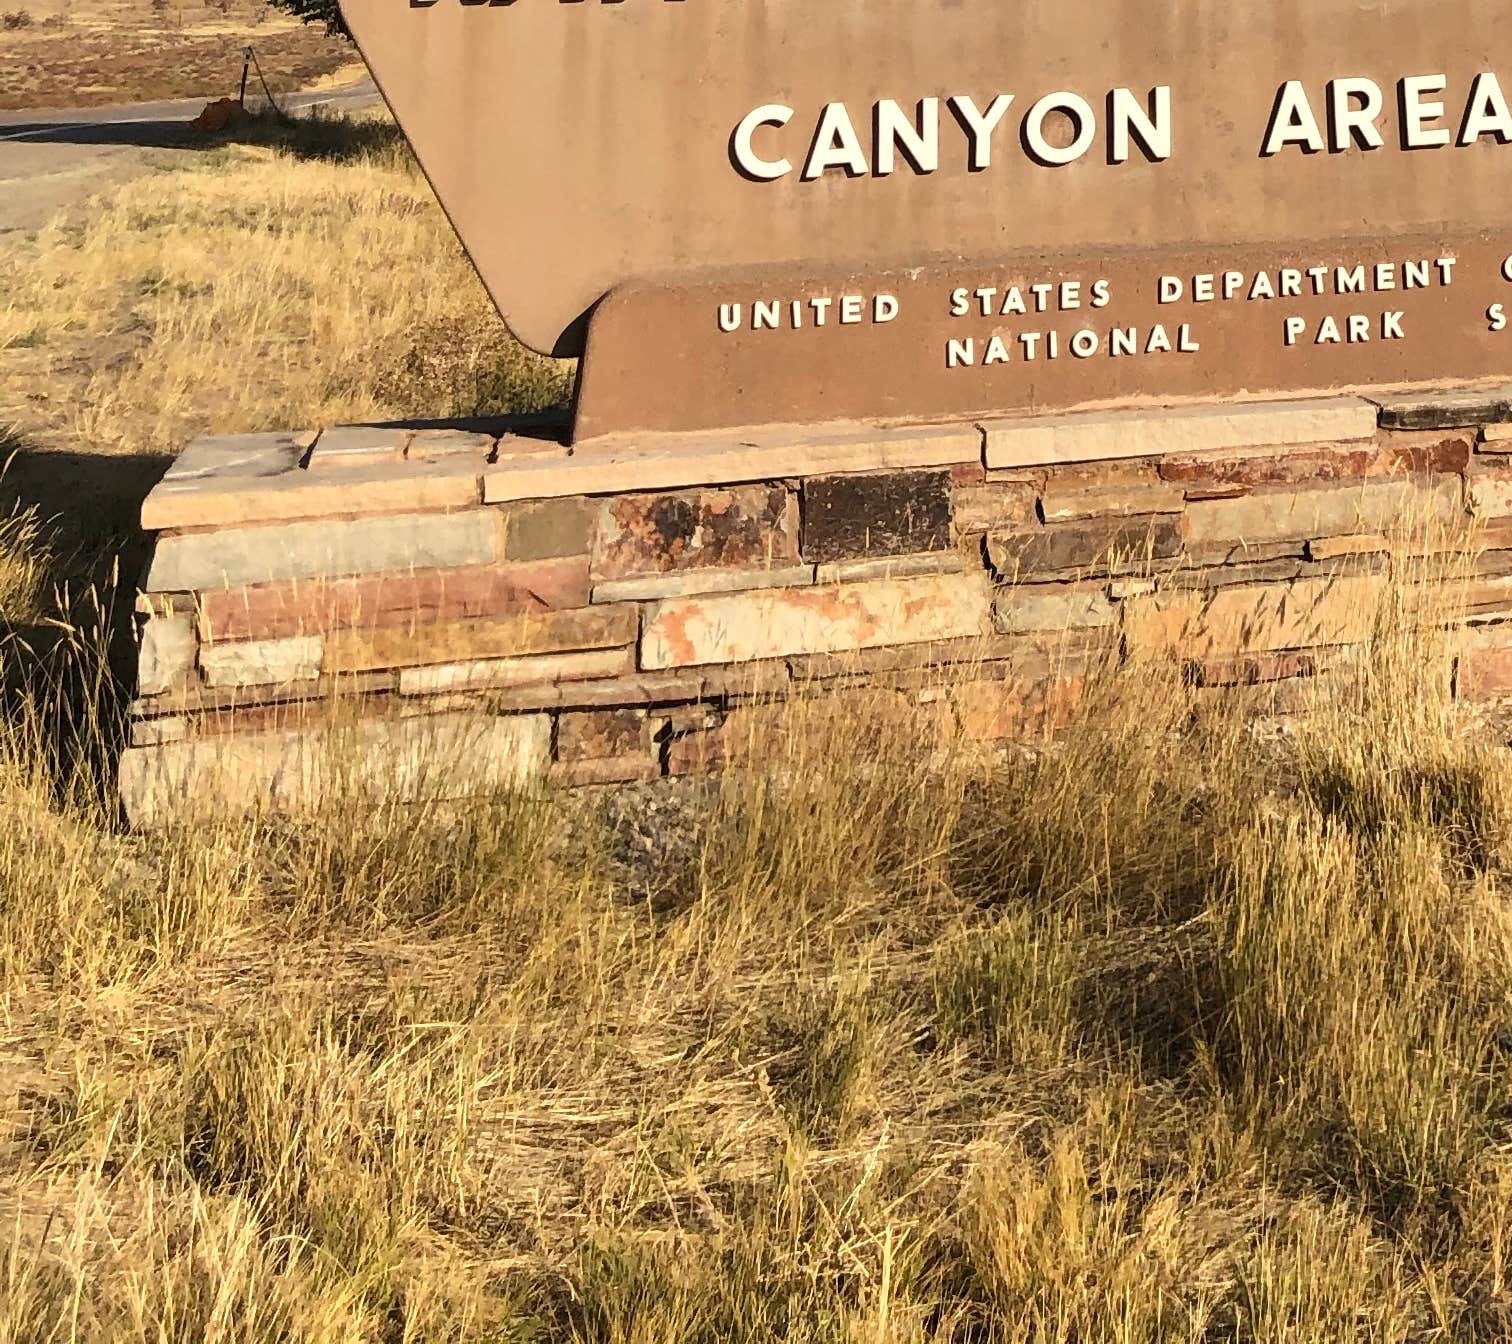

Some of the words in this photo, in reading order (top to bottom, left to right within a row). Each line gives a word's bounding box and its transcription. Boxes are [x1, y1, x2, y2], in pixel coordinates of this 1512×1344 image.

[733, 84, 1173, 179] CANYON
[719, 293, 900, 333] UNITED
[951, 278, 1111, 317] STATES
[1160, 256, 1458, 304] DEPARTMENT
[947, 322, 1201, 368] NATIONAL
[1285, 310, 1406, 345] PARK
